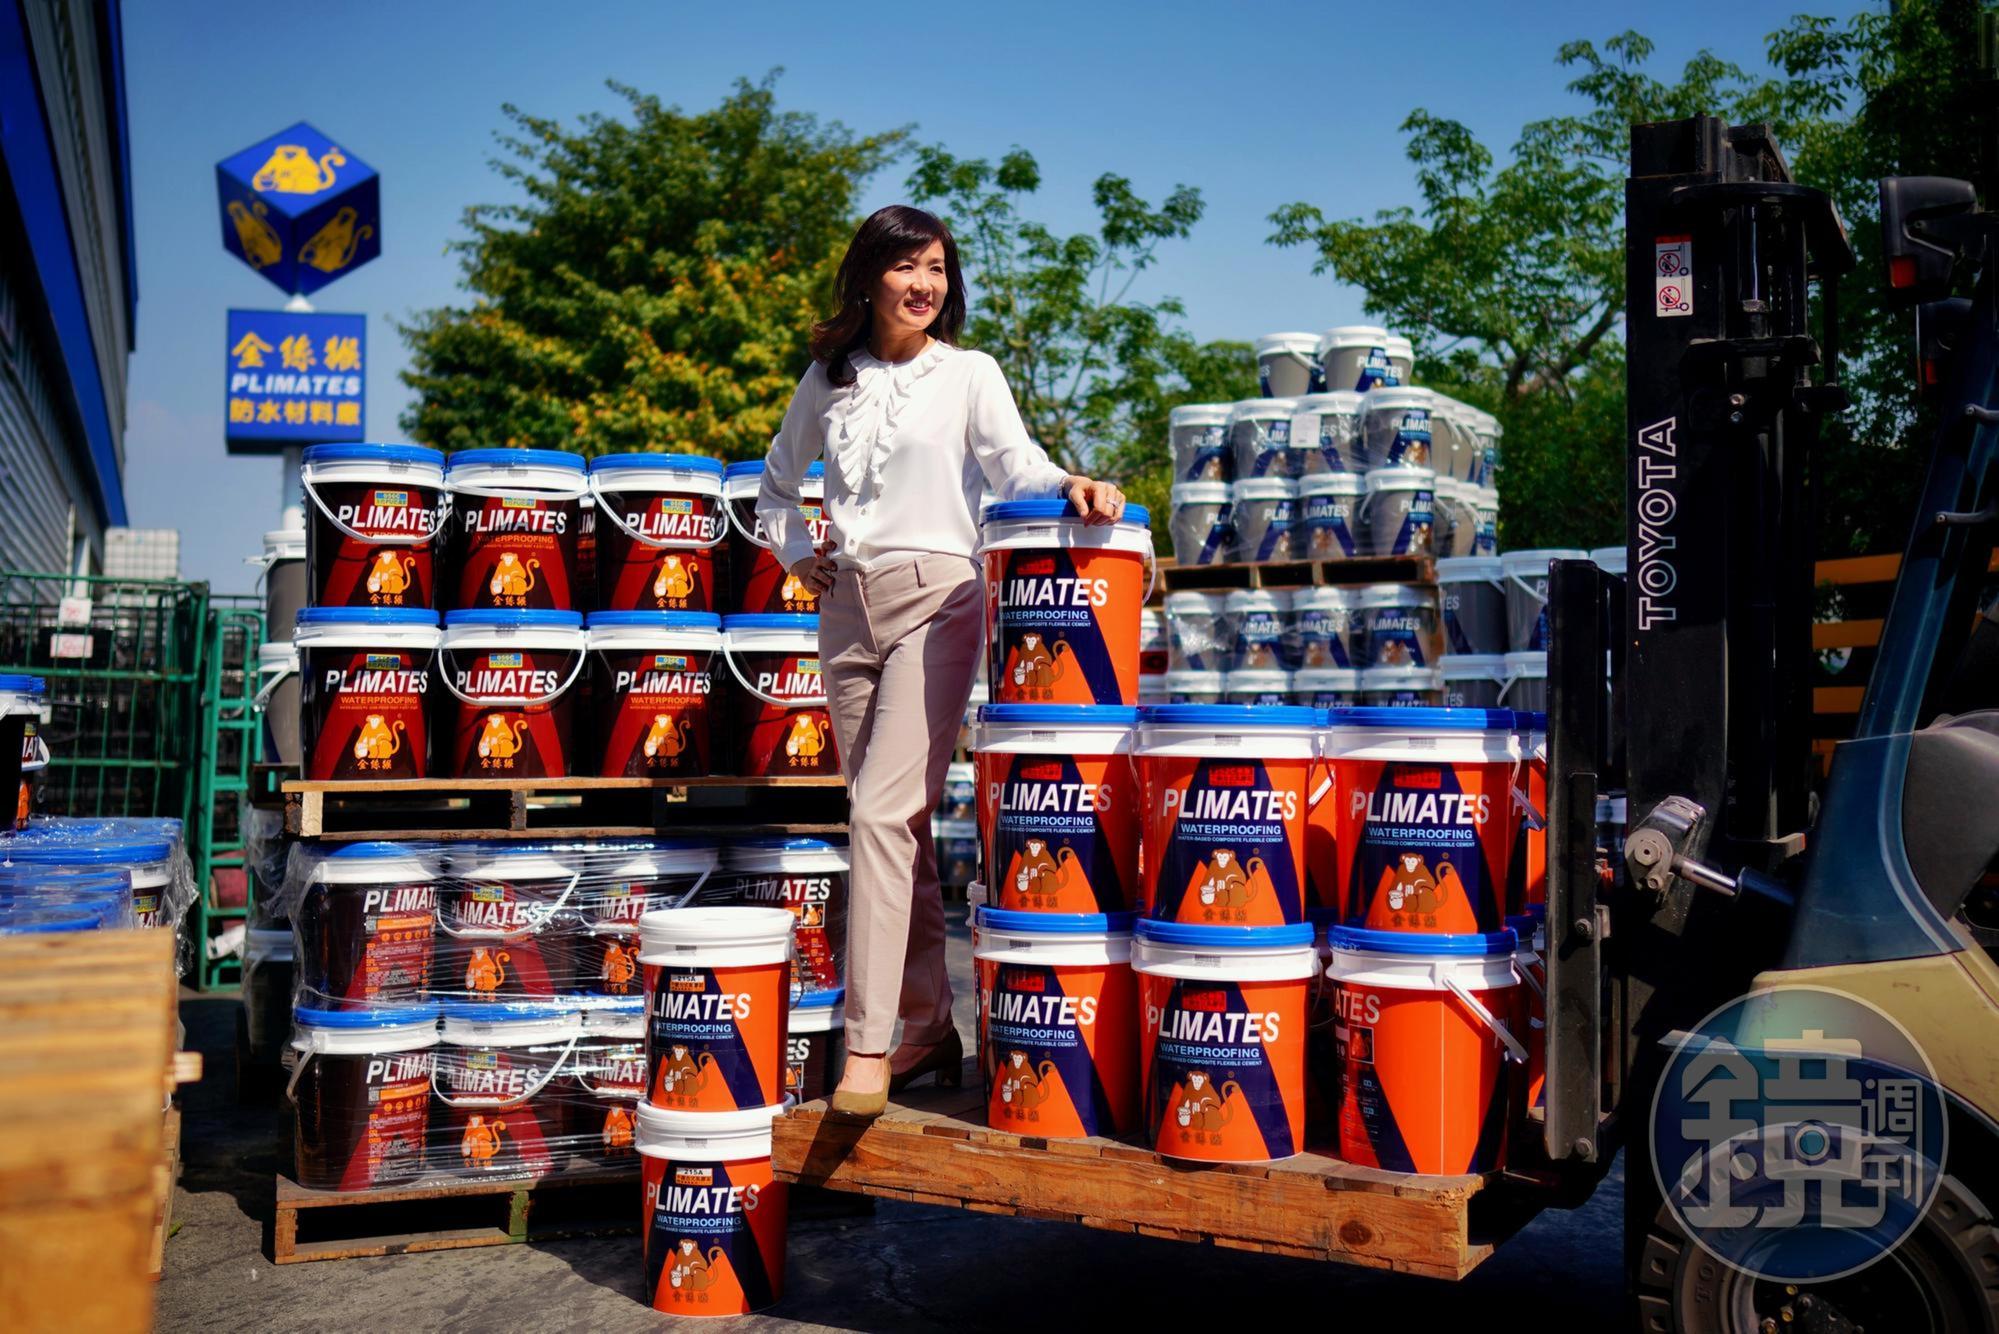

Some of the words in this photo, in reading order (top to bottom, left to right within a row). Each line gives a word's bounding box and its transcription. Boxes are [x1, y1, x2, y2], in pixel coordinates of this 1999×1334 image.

[230, 373, 361, 396] PLIMATES
[338, 505, 437, 533] PLIMATES
[465, 509, 567, 534] PLIMATES
[625, 513, 715, 539] PLIMATES
[1638, 416, 1676, 630] TOYOTA
[989, 578, 1110, 607] PLIMATES
[325, 670, 428, 693] PLIMATES
[456, 670, 558, 693] PLIMATES
[616, 671, 711, 694] PLIMATES
[757, 672, 828, 694] PLIMA
[341, 696, 417, 705] WATERPROOFING
[630, 696, 702, 705] WATERPROOFING
[990, 782, 1112, 812] PLIMATES
[1163, 788, 1298, 821] PLIMATES
[1352, 791, 1490, 824] PLIMATES
[1000, 815, 1093, 826] WATERPROOFING
[1181, 824, 1281, 835] WATERPROOFING
[1368, 827, 1473, 839] WATERPROOFING
[363, 886, 437, 913] PLIMAT
[736, 878, 832, 901] PLIMATES
[982, 989, 1097, 1025] PLIMATES
[1334, 988, 1380, 1025] ATES
[1147, 1007, 1281, 1043] PLIMATES
[1160, 1042, 1260, 1058] WATERPROOFING
[366, 1052, 430, 1084] PLIMA
[646, 1181, 761, 1214] PLIMATES
[656, 1214, 741, 1227] WATERPROOFING
